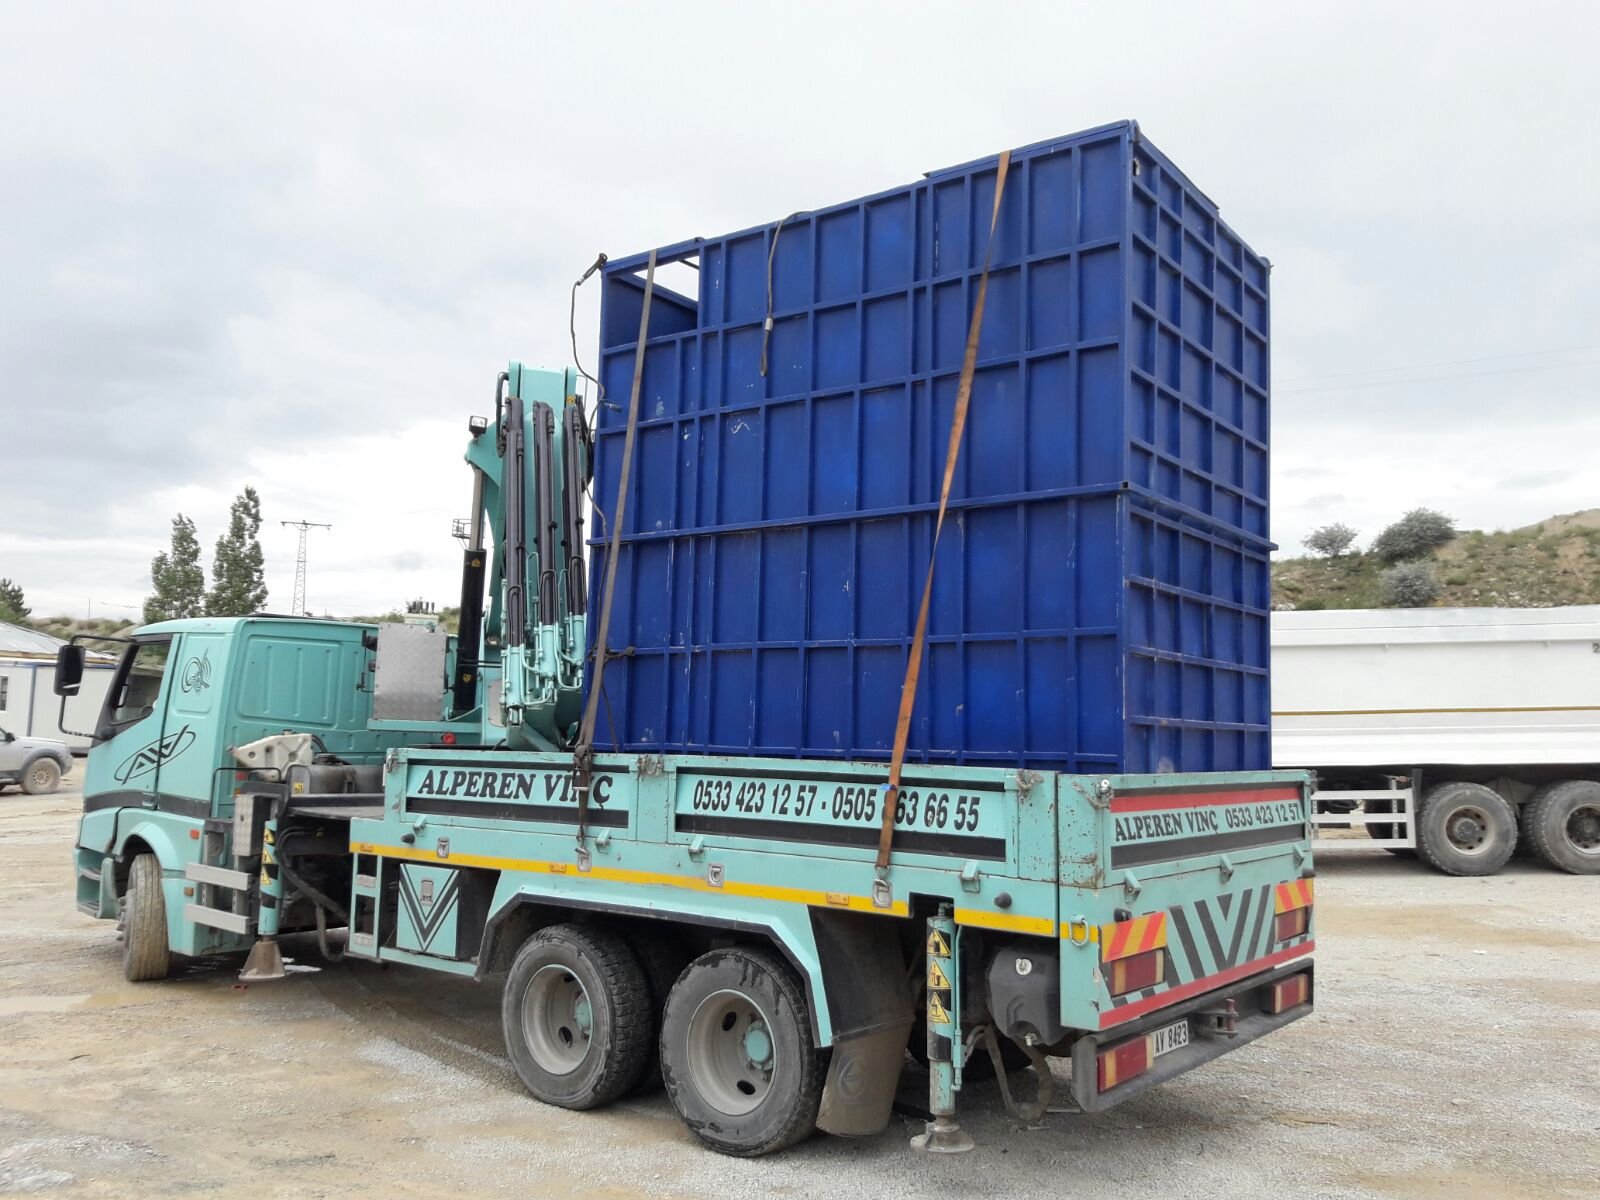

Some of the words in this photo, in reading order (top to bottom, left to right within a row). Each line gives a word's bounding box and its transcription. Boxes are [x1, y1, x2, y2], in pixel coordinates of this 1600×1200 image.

[417, 769, 536, 800] ALPEREN
[694, 780, 732, 812] 0533
[735, 781, 766, 813] 423
[772, 783, 793, 814] 12
[795, 785, 817, 816] 57
[832, 786, 877, 821] 0505
[881, 789, 919, 826] 63
[924, 792, 949, 829] 66
[954, 796, 981, 832] 55
[1115, 812, 1184, 842] ALPEREN
[1225, 808, 1253, 829] 0533
[1255, 805, 1274, 824] 423
[1275, 804, 1289, 823] 12
[1288, 803, 1300, 821] 57
[1168, 1023, 1187, 1048] 8423
